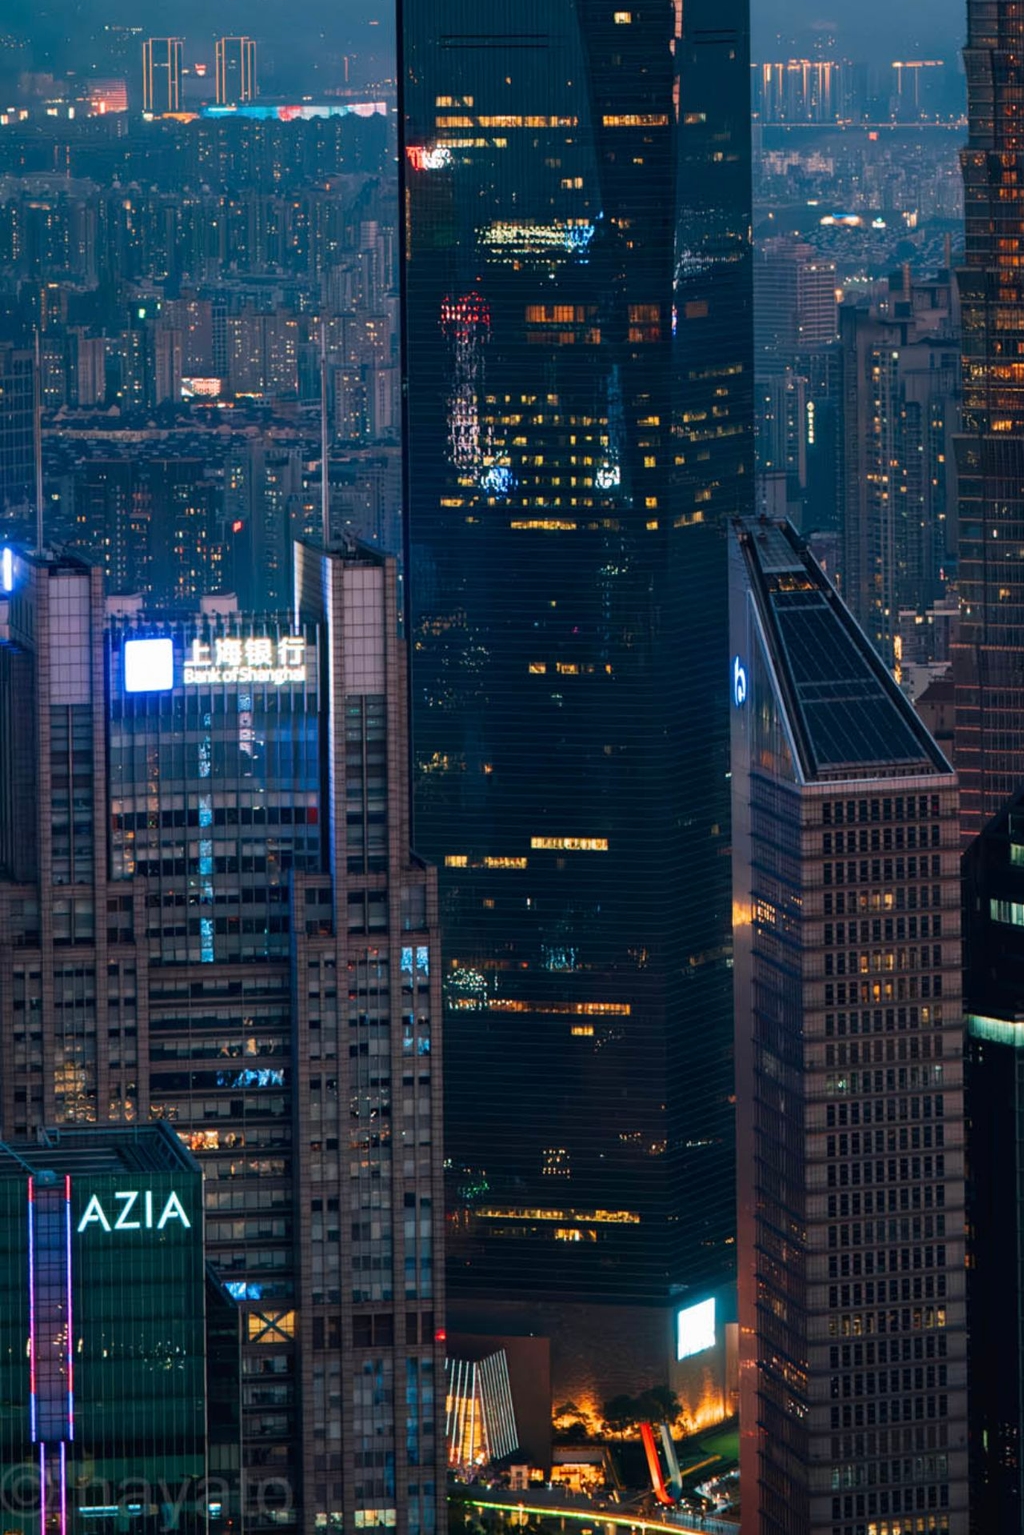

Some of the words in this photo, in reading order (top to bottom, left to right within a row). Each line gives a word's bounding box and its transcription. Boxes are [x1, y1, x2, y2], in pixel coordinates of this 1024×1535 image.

[184, 636, 306, 666] 上海银行
[184, 667, 221, 684] Bank
[222, 667, 238, 683] of
[238, 665, 306, 685] Shanghai
[77, 1191, 191, 1232] AZIA
